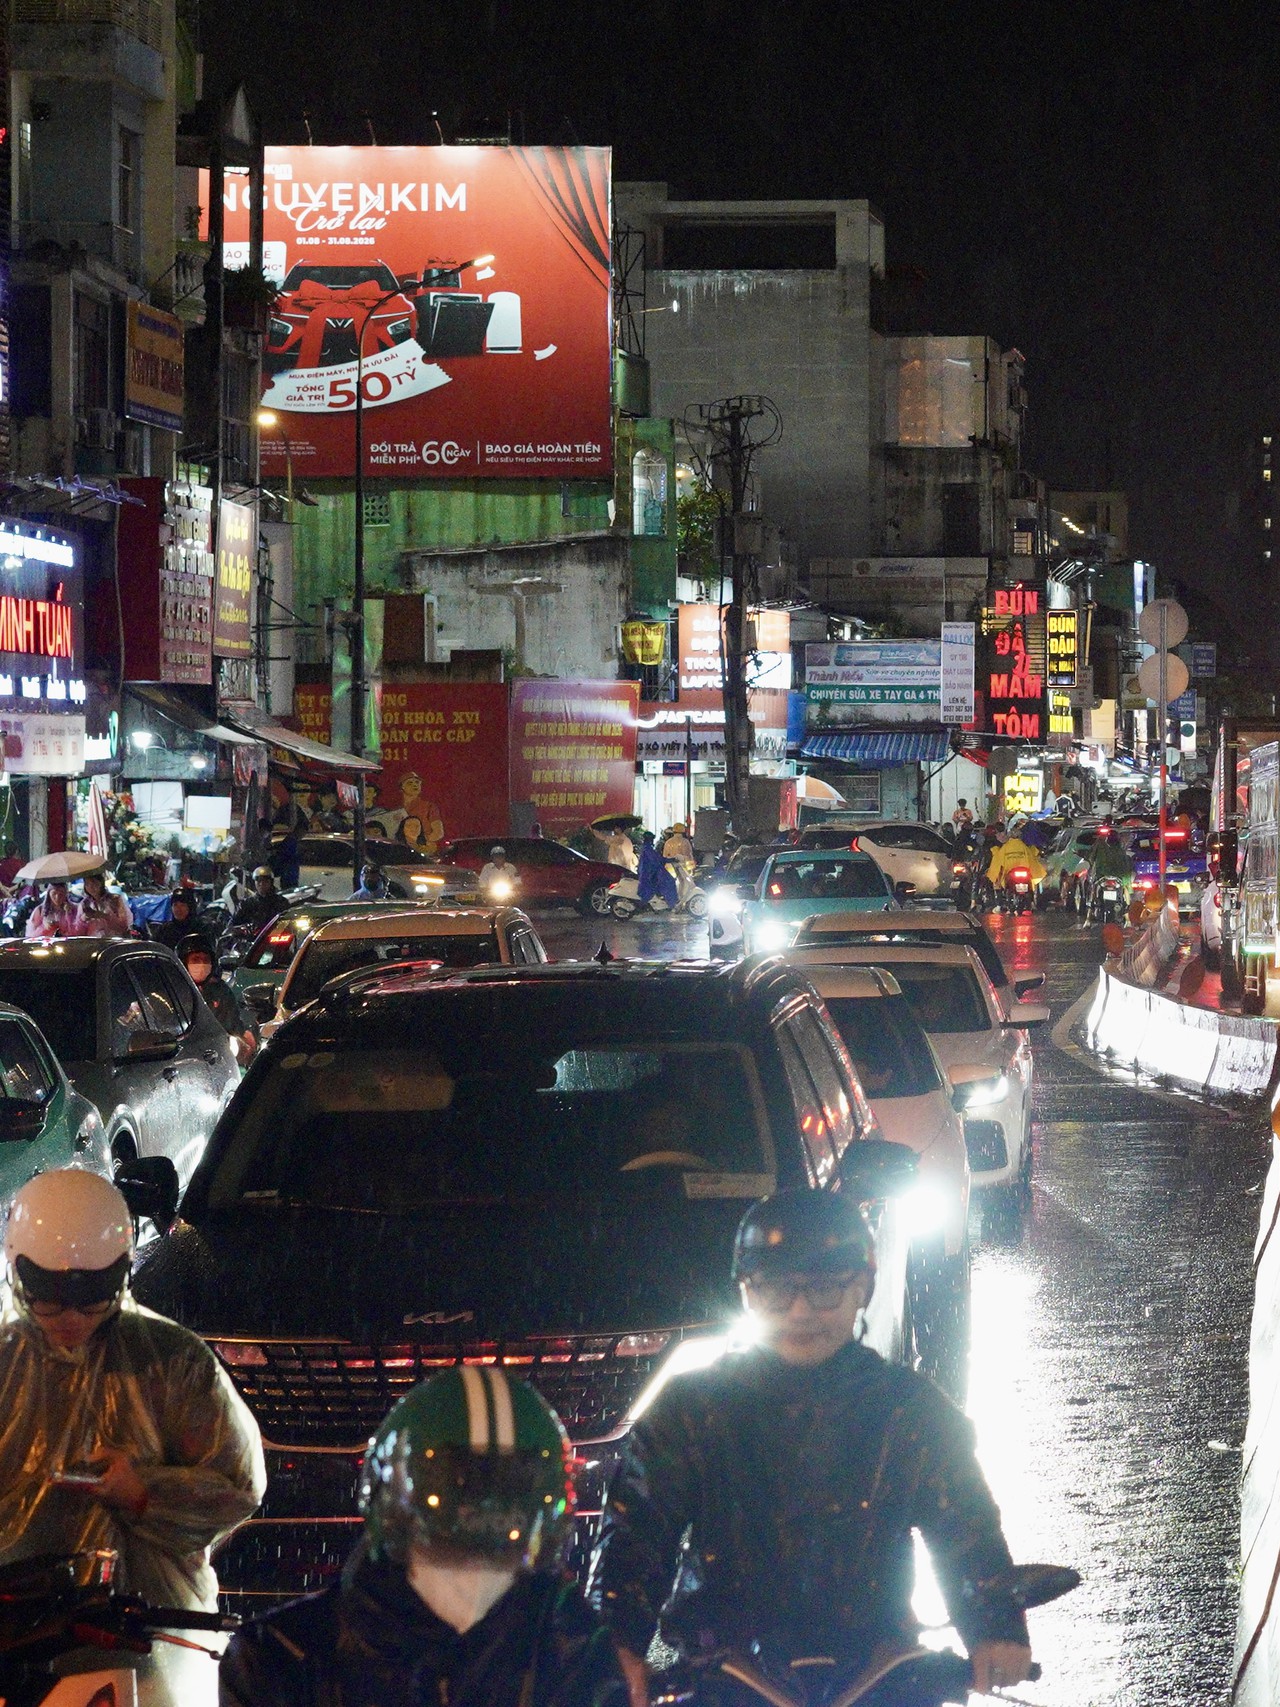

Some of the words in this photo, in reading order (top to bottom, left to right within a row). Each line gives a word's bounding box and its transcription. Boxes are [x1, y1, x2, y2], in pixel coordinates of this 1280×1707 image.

[349, 195, 390, 235] lại
[286, 393, 304, 402] GIÁ
[327, 371, 392, 409] 50
[370, 442, 391, 453] ĐỔI
[394, 441, 416, 453] TRẢ
[421, 440, 459, 465] 60
[446, 447, 471, 458] NGÀY
[486, 444, 511, 454] BAO
[513, 442, 534, 454] GIÁ
[537, 441, 572, 454] HOÀN
[575, 440, 601, 454] TIỀN
[370, 453, 396, 464] MIỄN
[995, 583, 1038, 616] BÚN
[36, 581, 72, 658] TUẤN
[1049, 614, 1074, 633] BÚN
[1049, 635, 1074, 657] ĐẬU
[810, 687, 846, 700] CHUYÊN
[849, 686, 866, 700] SỬA
[869, 690, 881, 699] XE
[884, 690, 902, 700] TAY
[905, 690, 916, 700] GA
[918, 690, 925, 699] 4
[993, 706, 1039, 738] TÔM
